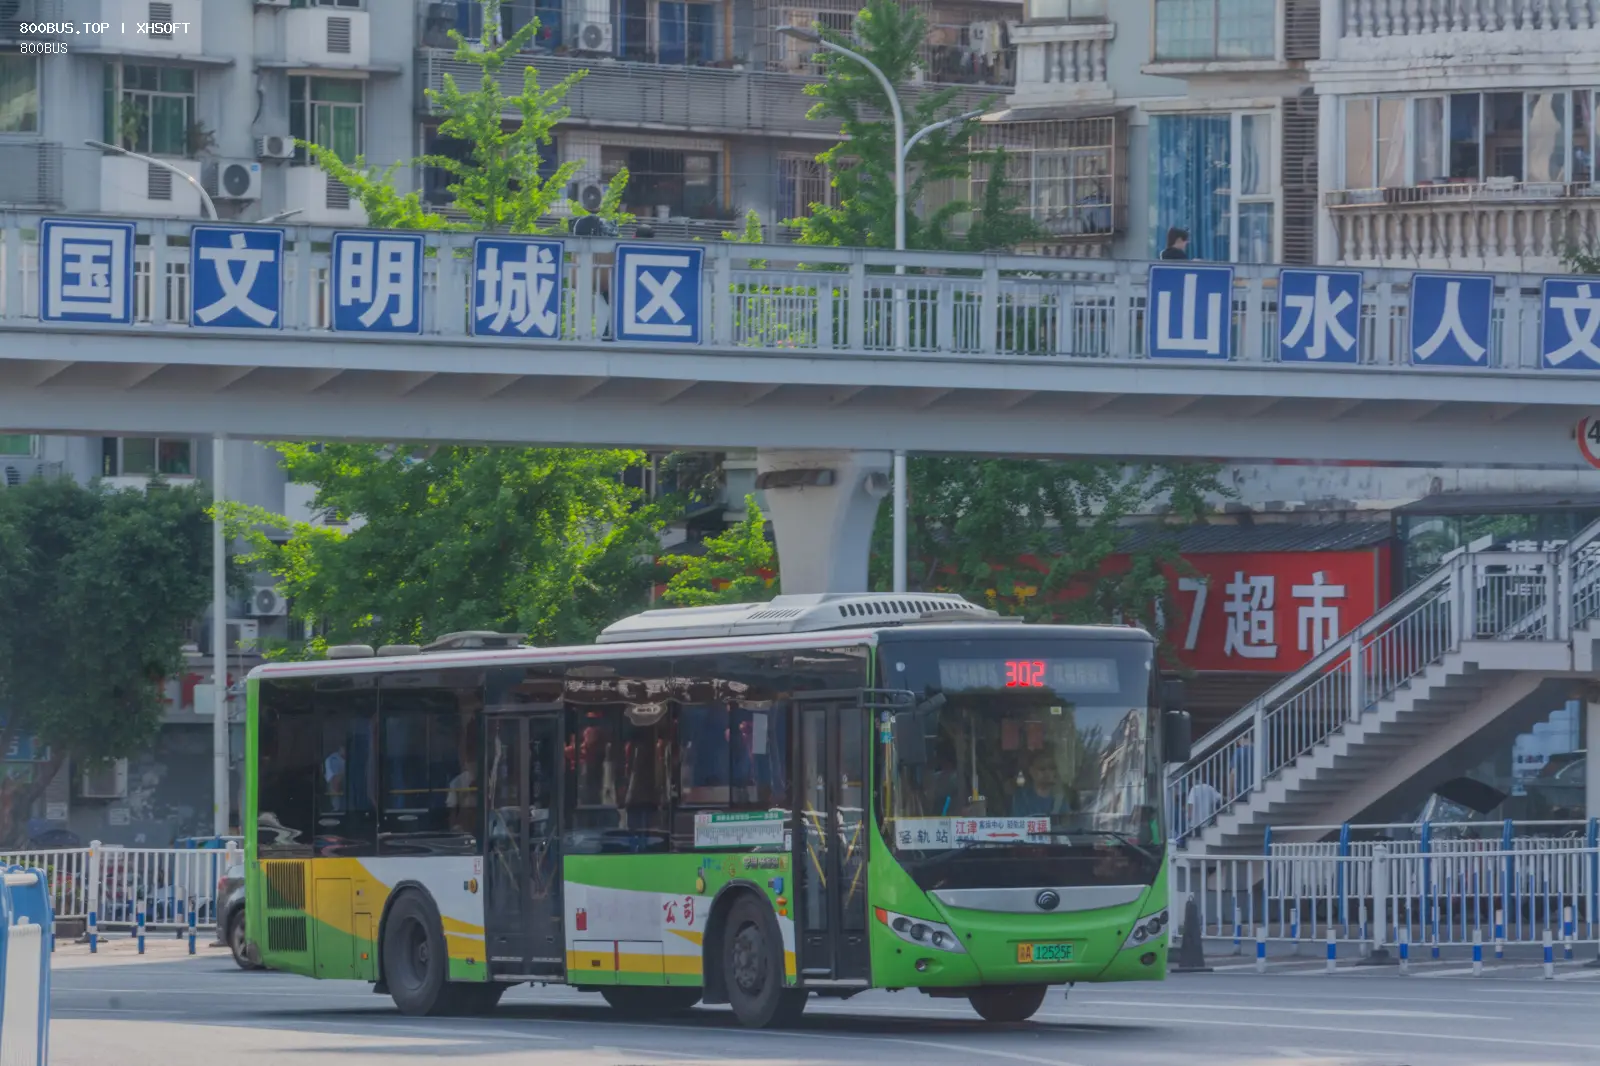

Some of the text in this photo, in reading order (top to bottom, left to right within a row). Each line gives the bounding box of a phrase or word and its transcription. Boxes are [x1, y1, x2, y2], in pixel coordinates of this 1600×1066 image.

[48, 226, 1600, 366] 国文明城区 山水人文
[1005, 660, 1046, 688] 302
[955, 820, 978, 834] 江津
[663, 896, 695, 926] 公司
